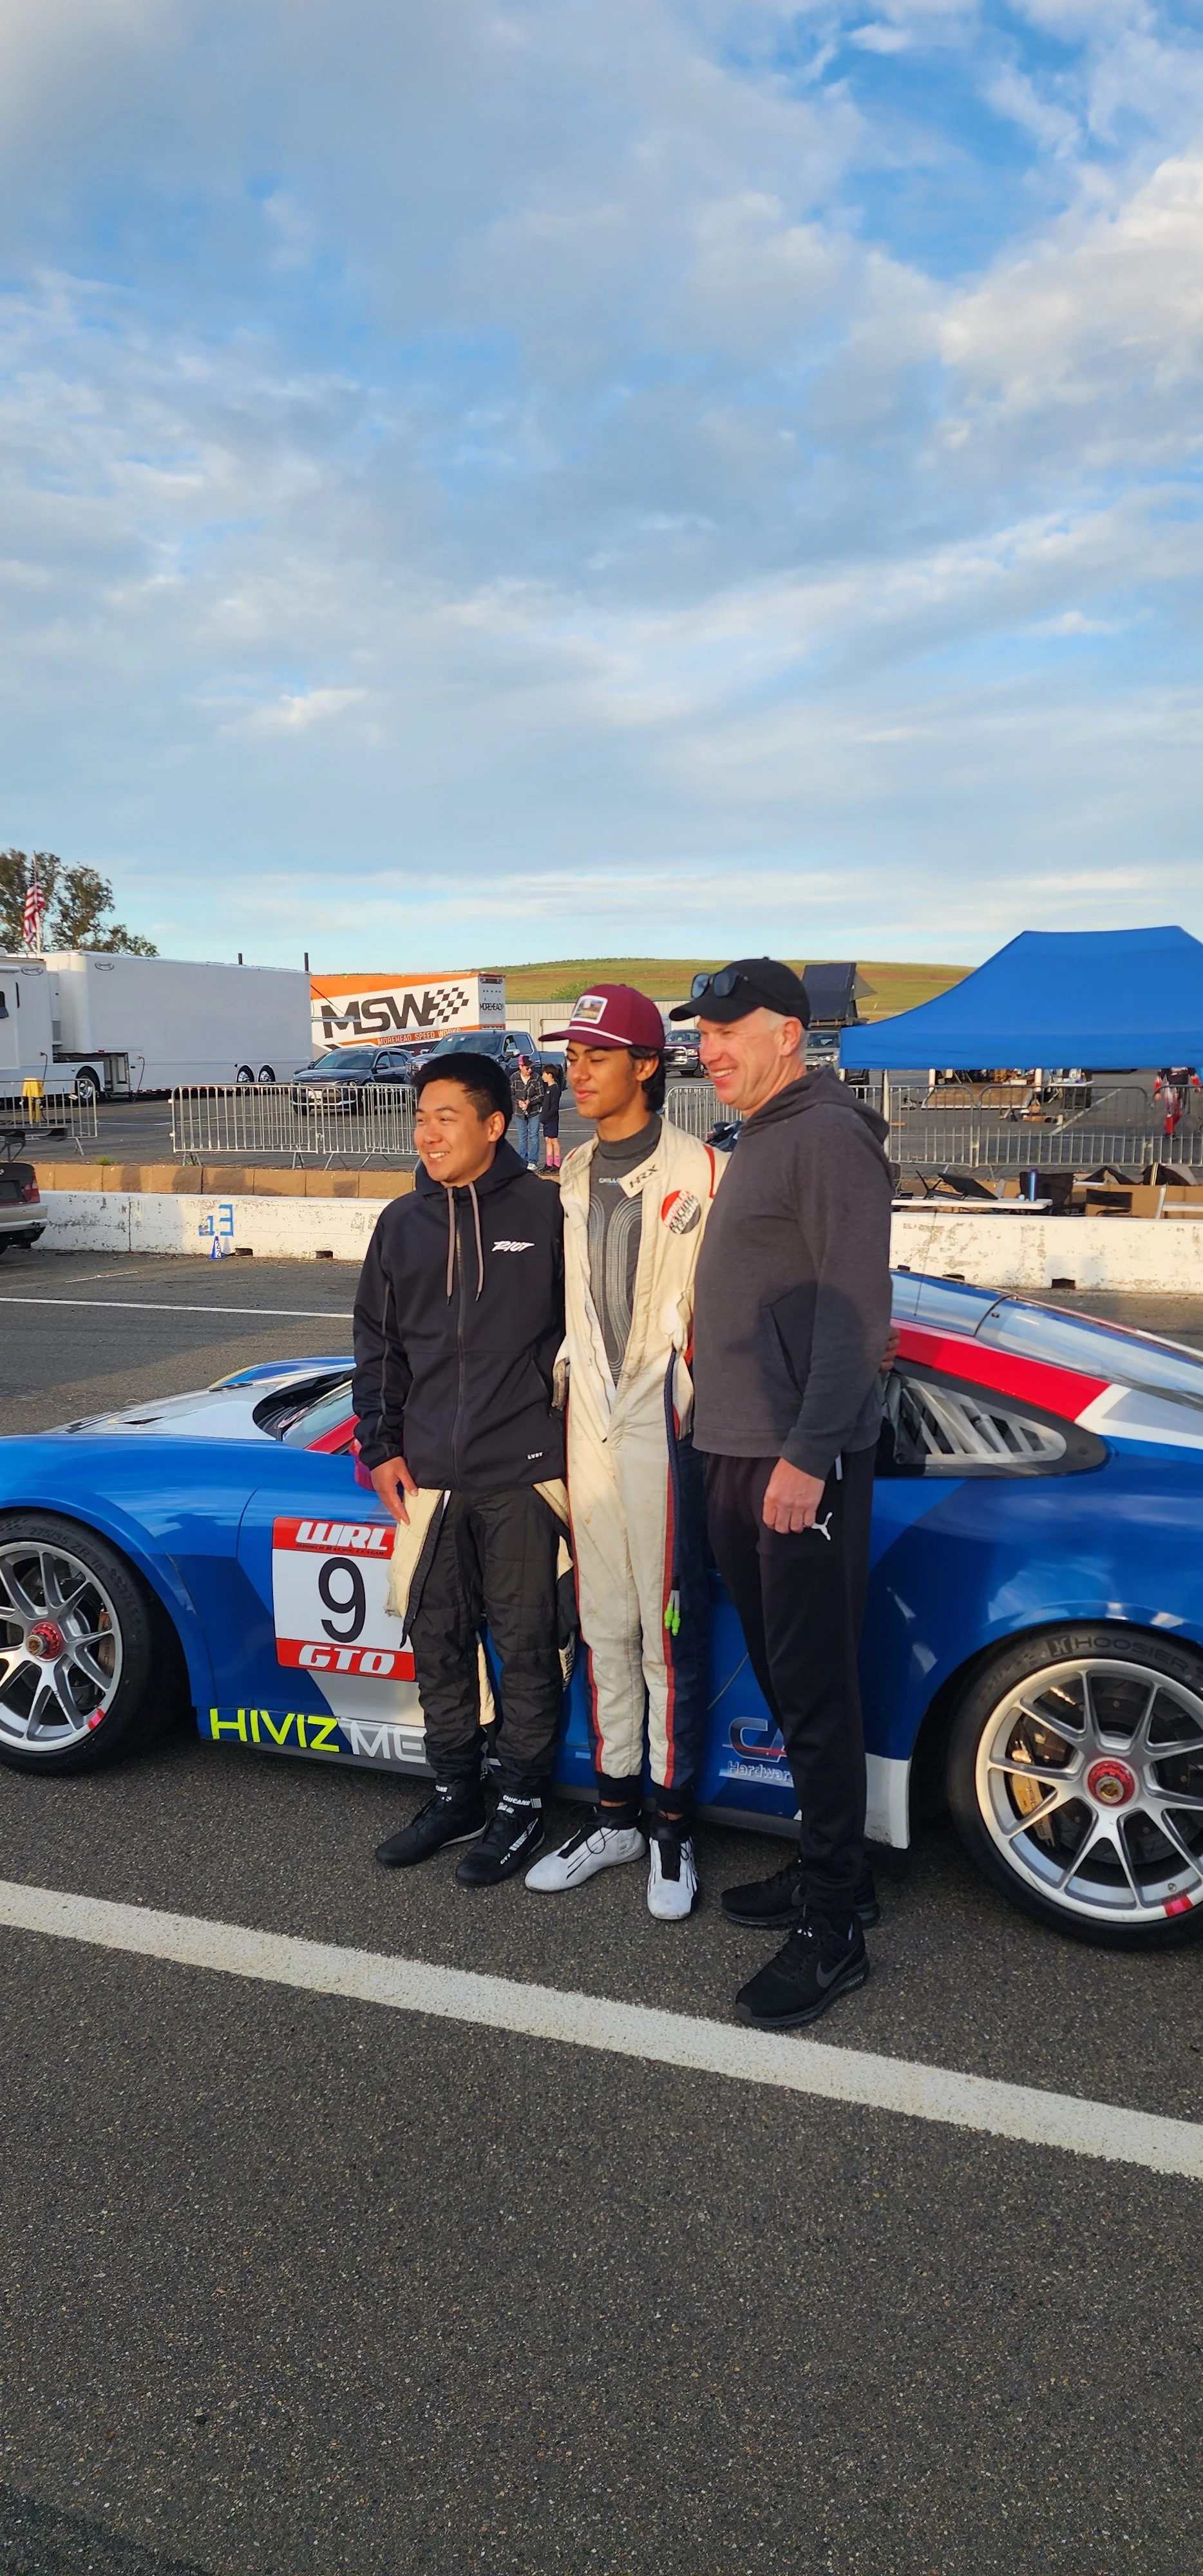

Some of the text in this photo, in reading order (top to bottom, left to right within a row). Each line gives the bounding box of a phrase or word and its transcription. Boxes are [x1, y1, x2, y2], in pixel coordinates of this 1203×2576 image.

[321, 990, 435, 1039] MSW
[377, 1033, 412, 1046] MOREHEAD
[414, 1030, 435, 1041] SPEED
[296, 1521, 387, 1551] WRL
[318, 1557, 366, 1643] 9
[298, 1644, 395, 1675] GTO
[1075, 1636, 1189, 1672] HOOSIER
[209, 1708, 339, 1752] HIVIZ
